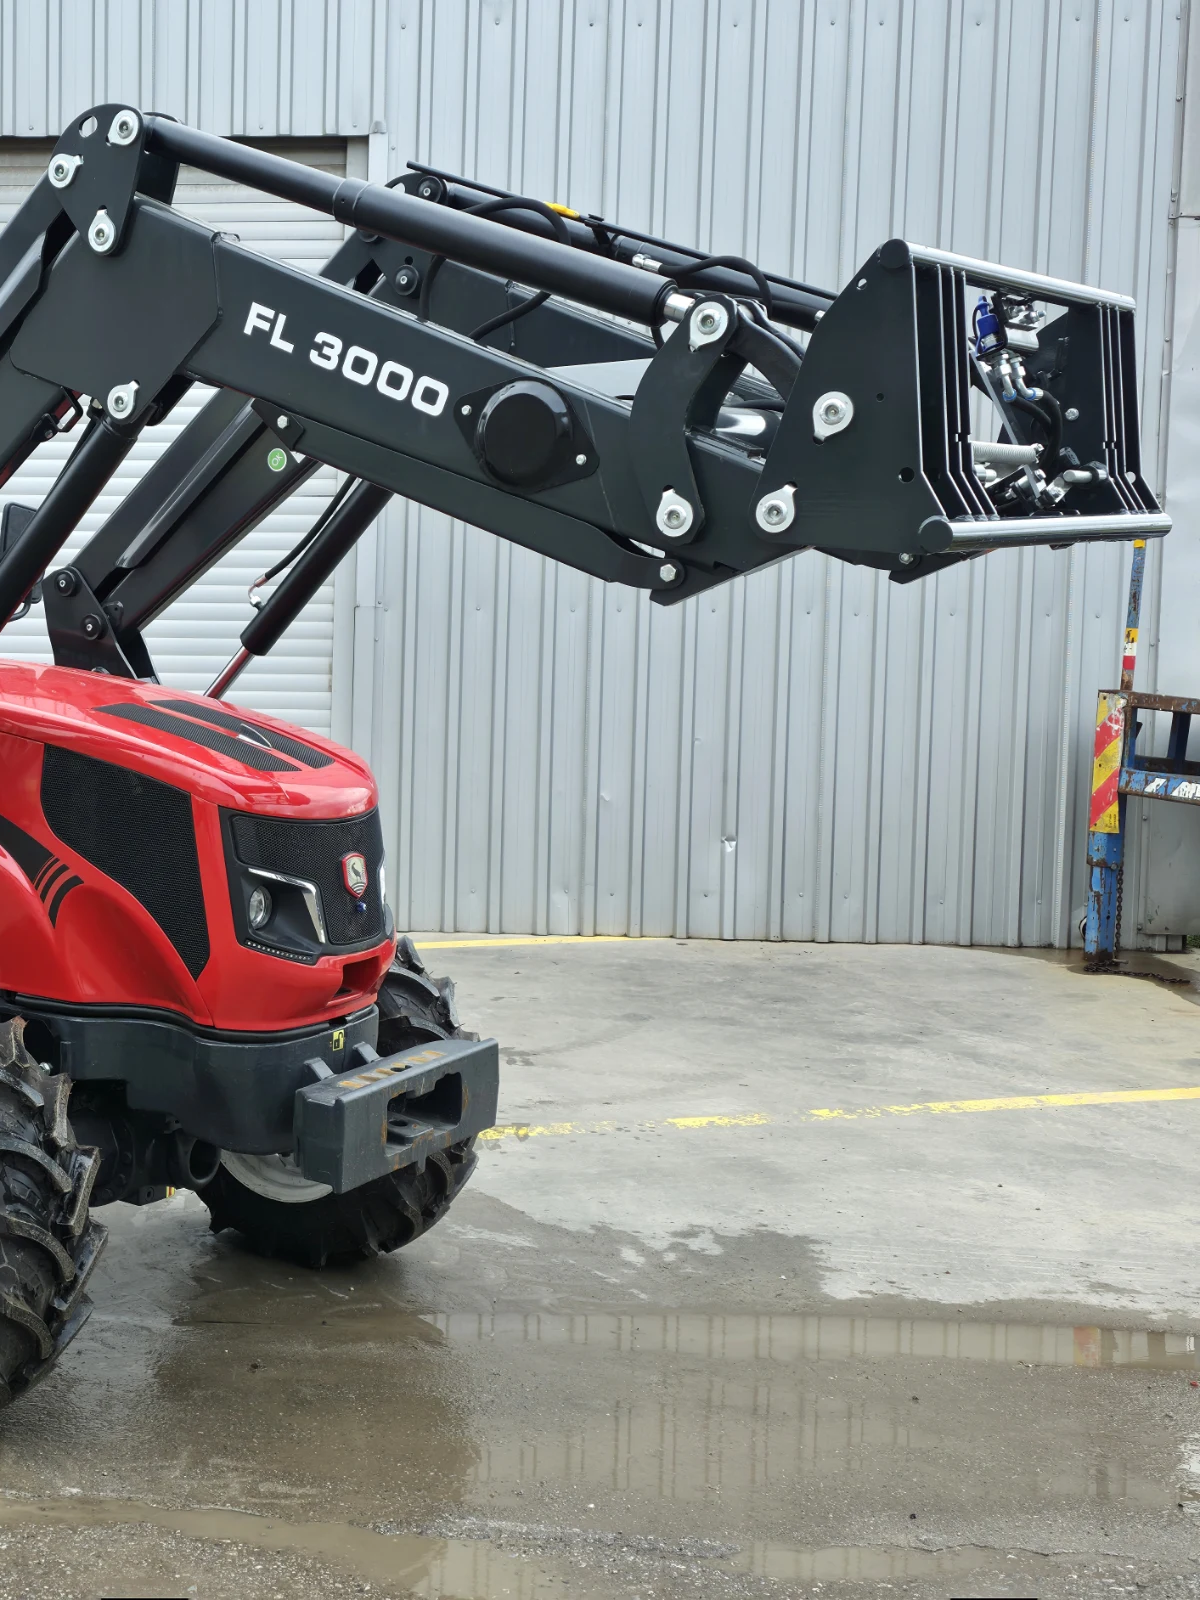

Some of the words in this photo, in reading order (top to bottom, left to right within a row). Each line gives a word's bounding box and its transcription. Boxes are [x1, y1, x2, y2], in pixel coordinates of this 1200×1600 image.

[243, 301, 294, 353] FL
[309, 331, 449, 417] 3000
[271, 453, 283, 466] OK
